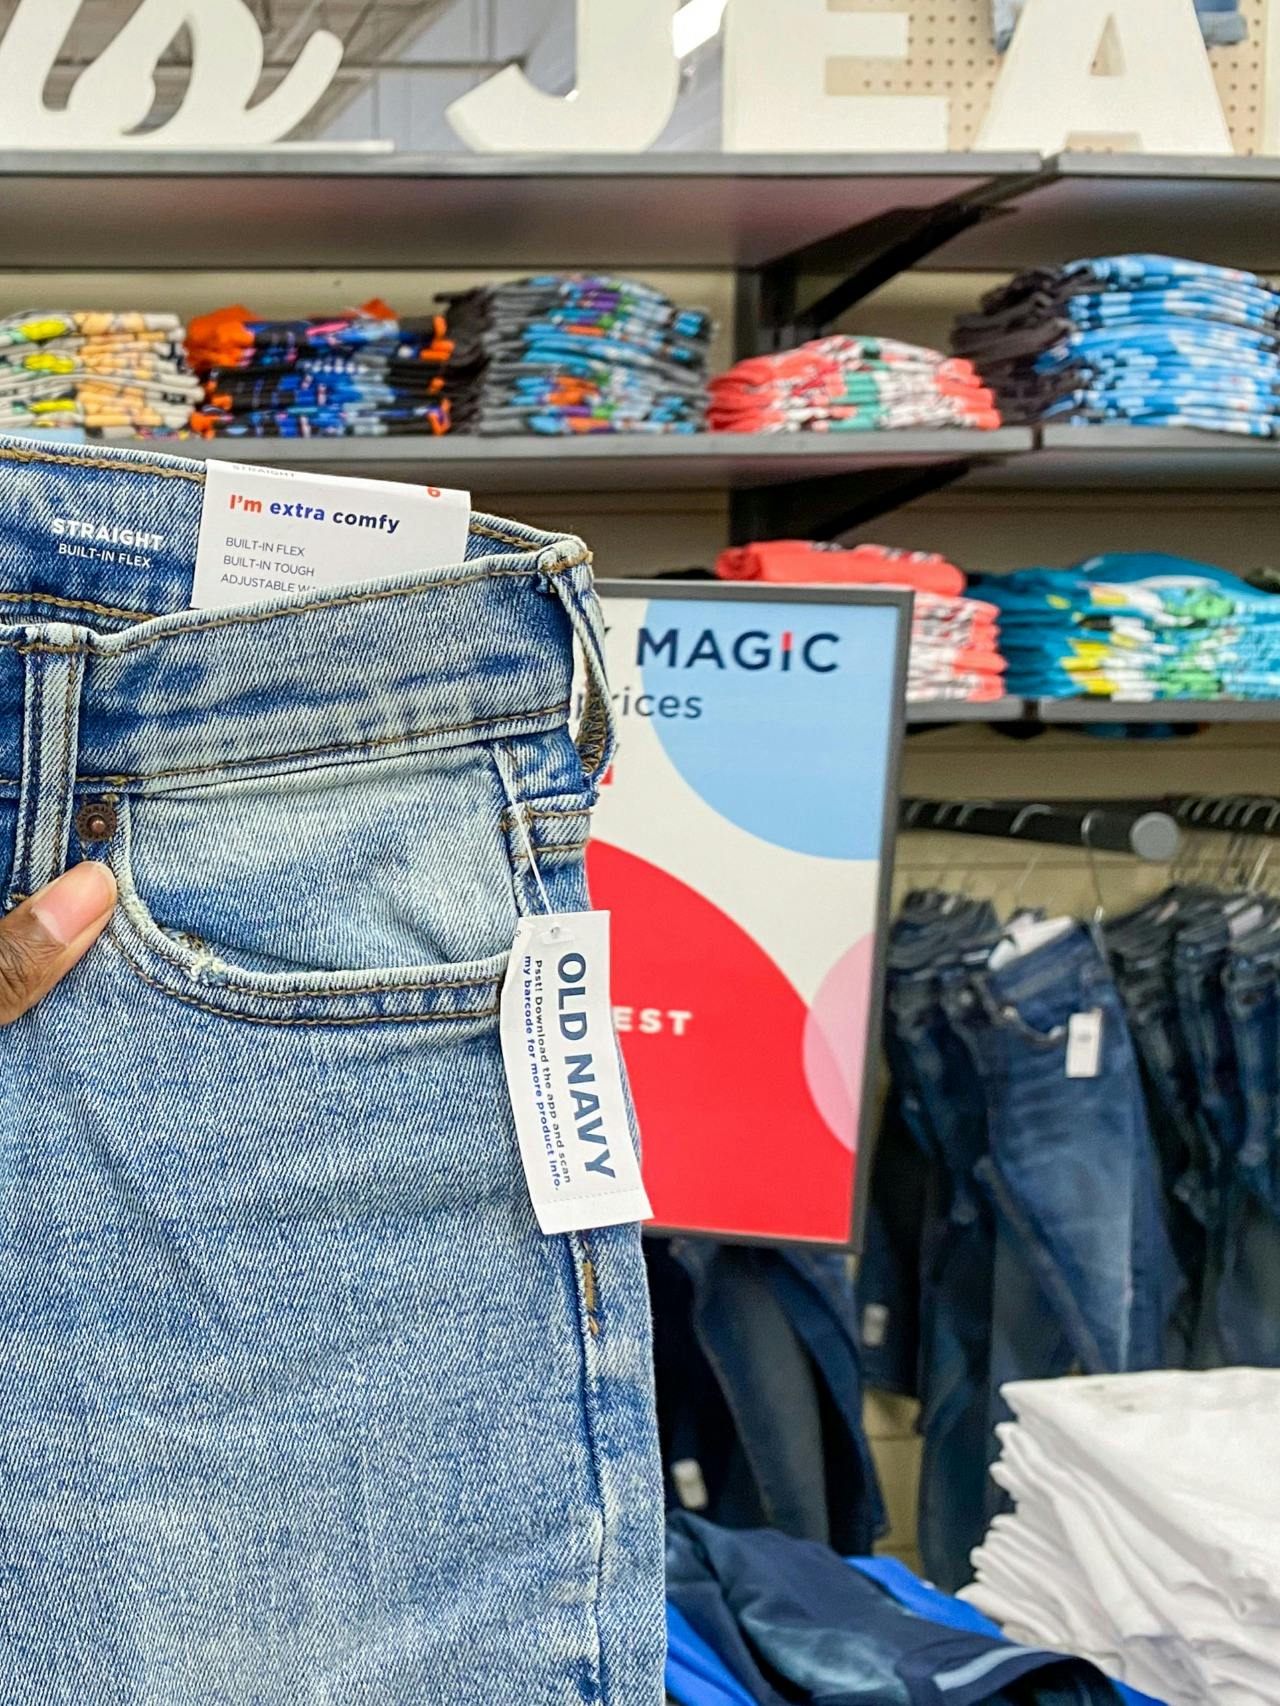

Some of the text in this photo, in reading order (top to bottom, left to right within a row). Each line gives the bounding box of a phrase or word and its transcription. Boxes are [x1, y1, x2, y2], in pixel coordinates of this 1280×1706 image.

[445, 0, 1280, 154] JEA
[229, 494, 400, 534] I'm extra comfy
[51, 518, 166, 551] STRAIGHT
[225, 536, 306, 557] BUILT-IN FLEX
[58, 543, 152, 569] BUILT-IN FLEX
[223, 555, 315, 577] BUILT-IN TOUGH
[220, 573, 296, 592] ADJUSTABLE
[636, 627, 841, 673] MAGIC
[523, 955, 532, 975] my
[524, 979, 534, 1035] barcode
[527, 1039, 536, 1058] for
[557, 952, 616, 1179] OLD NAVY
[531, 1063, 542, 1097] more
[535, 996, 549, 1063] Download
[542, 1067, 552, 1089] the
[547, 1093, 557, 1119] app
[553, 1123, 565, 1148] and
[559, 1152, 571, 1183] scan
[536, 1101, 555, 1156] product
